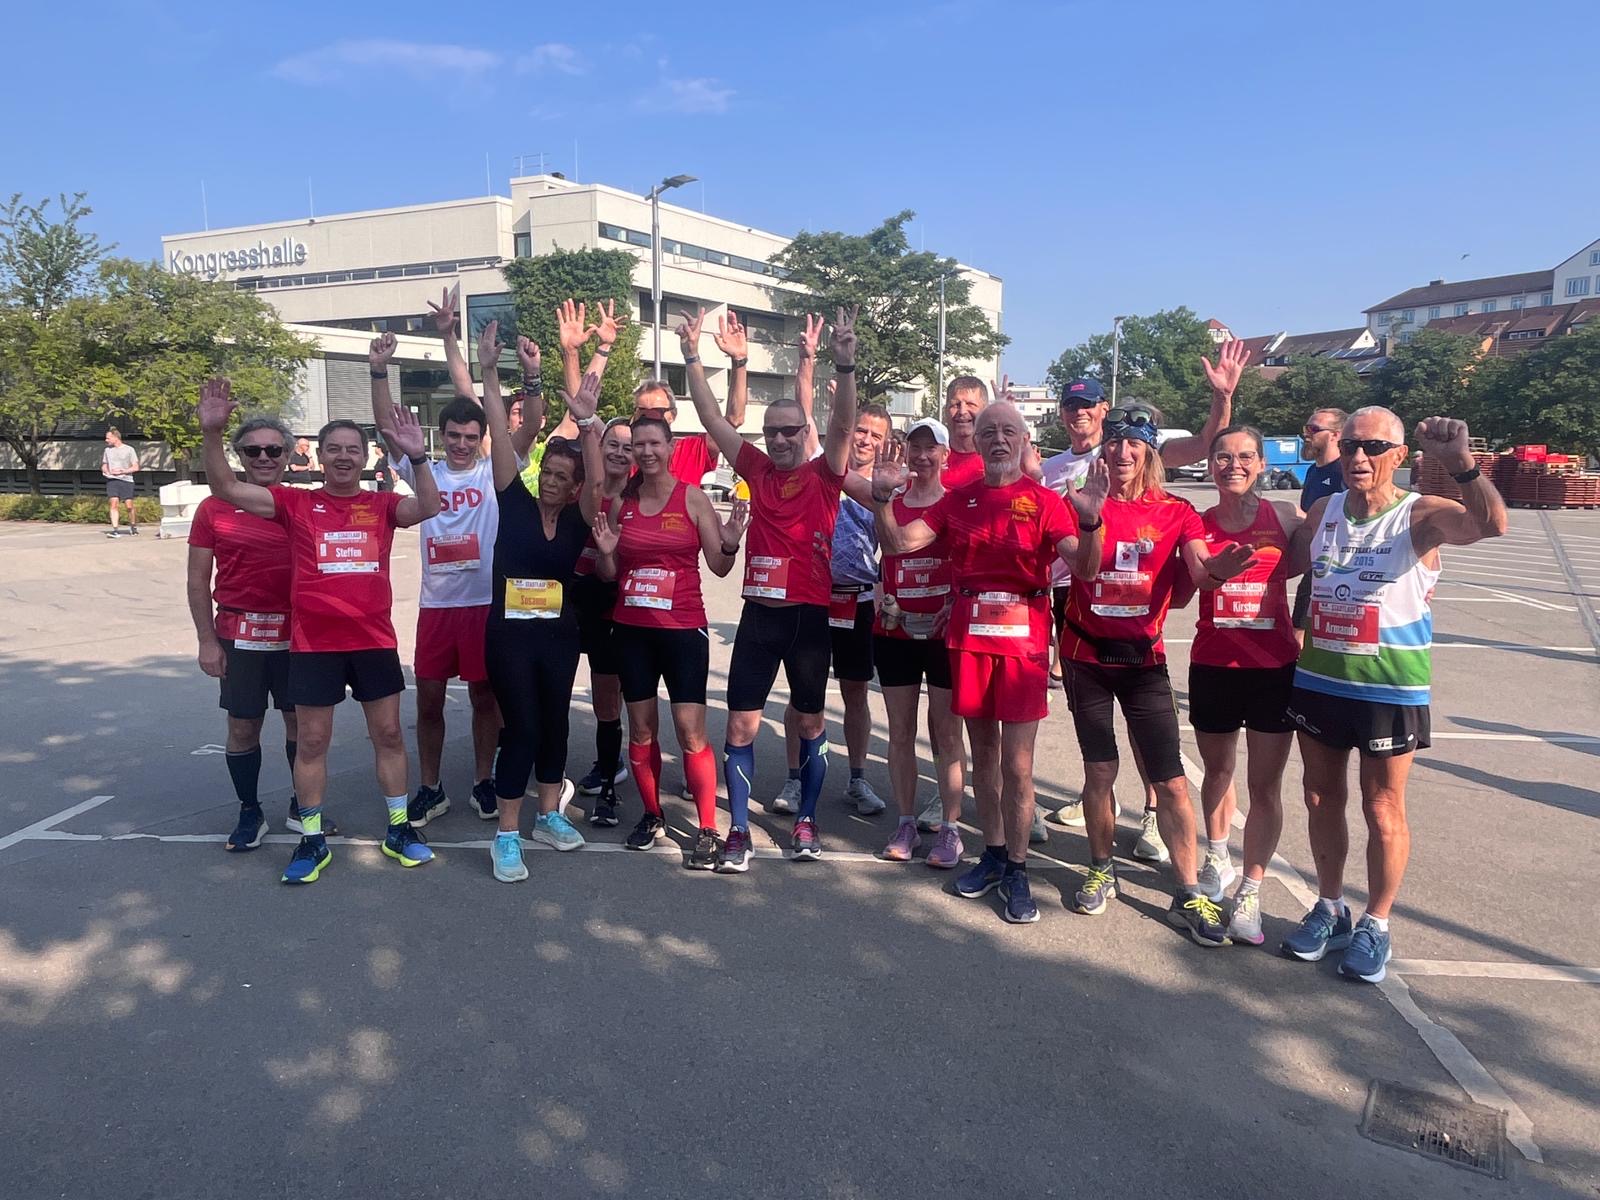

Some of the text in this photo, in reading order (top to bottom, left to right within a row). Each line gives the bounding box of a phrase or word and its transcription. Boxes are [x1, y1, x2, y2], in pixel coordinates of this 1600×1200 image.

[169, 238, 307, 279] Kongresshalle
[439, 487, 483, 512] SPD
[335, 547, 362, 558] Steffen
[1353, 556, 1375, 567] 2015
[1325, 622, 1359, 637] Armando
